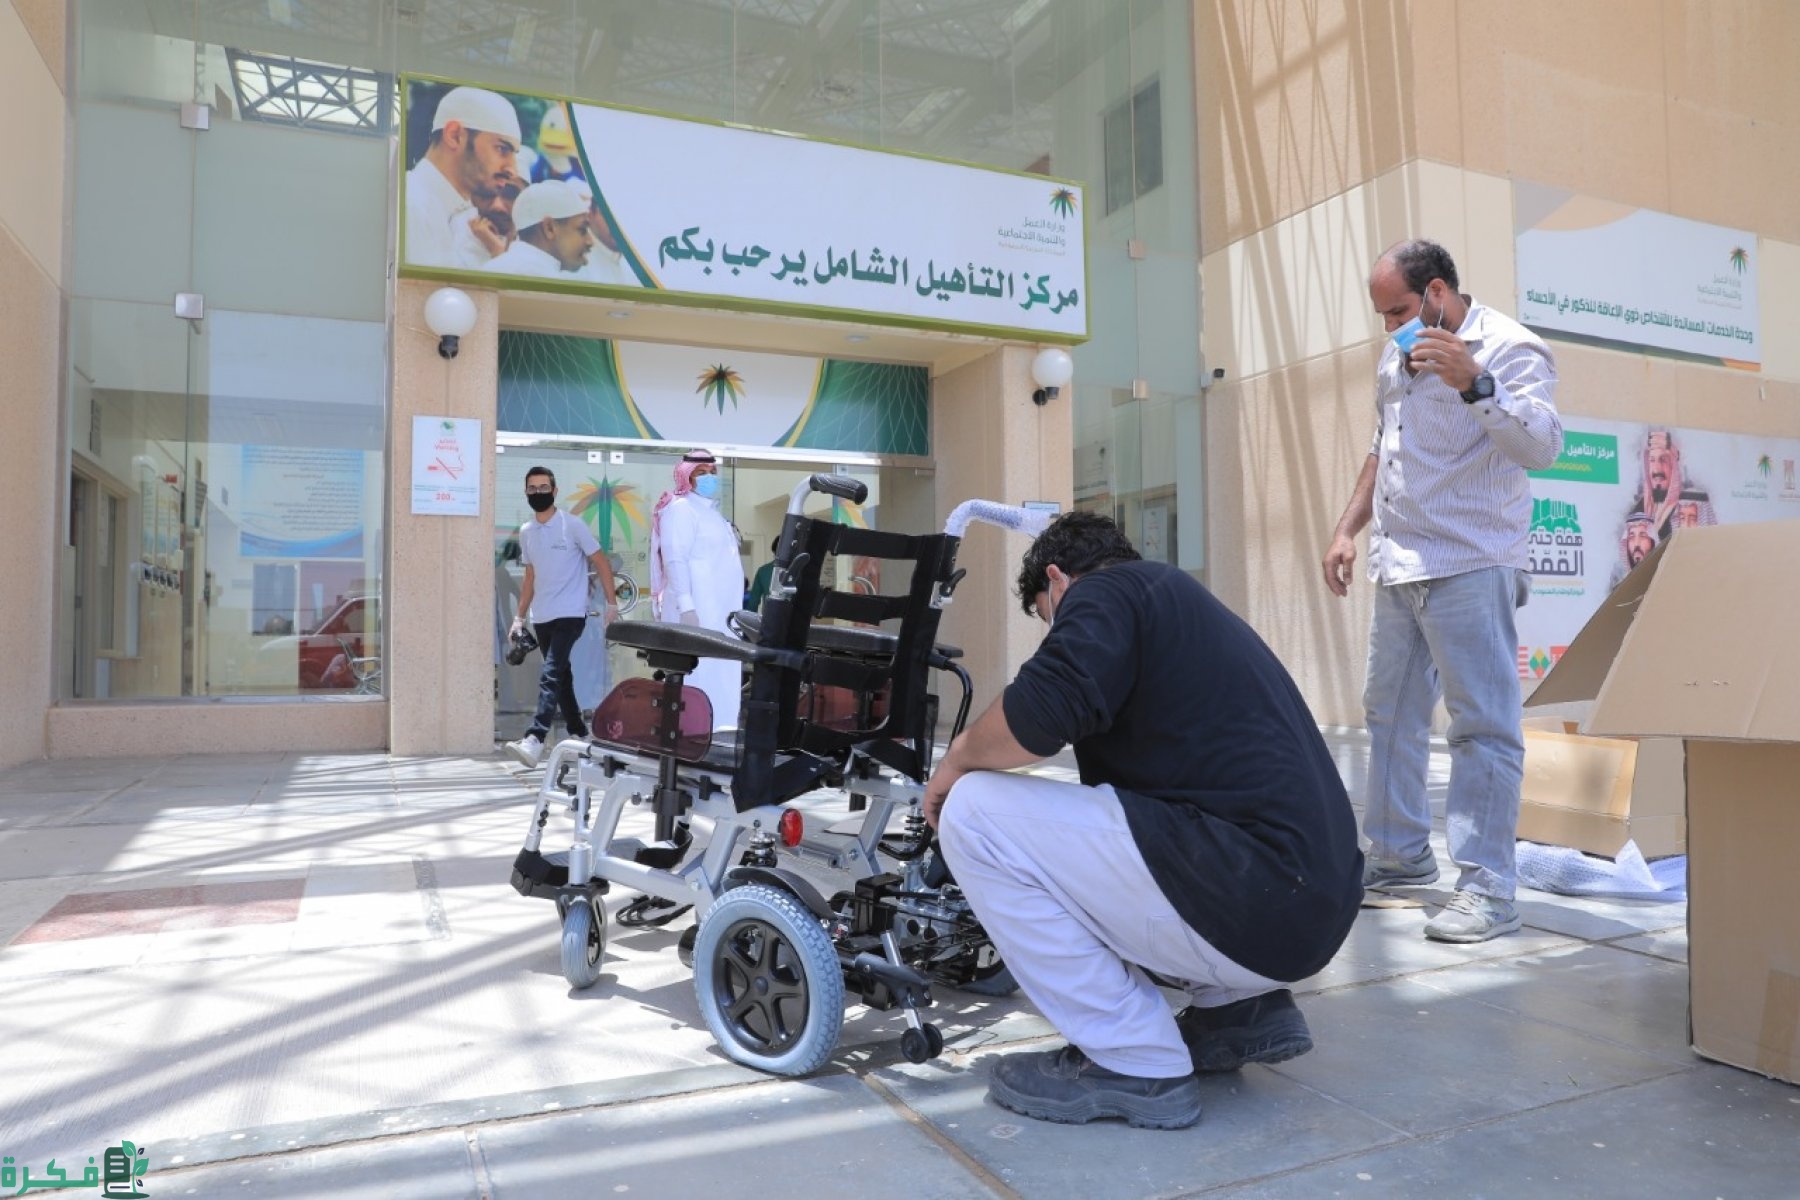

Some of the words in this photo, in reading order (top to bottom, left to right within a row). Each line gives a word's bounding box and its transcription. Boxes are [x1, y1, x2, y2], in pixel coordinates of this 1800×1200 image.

[658, 226, 714, 276] بكم
[722, 242, 808, 286] يرحب
[813, 246, 908, 287] الشامل
[916, 262, 1014, 301] التأهيل
[1019, 271, 1079, 314] مركز
[1526, 286, 1556, 305] الأحساء
[1558, 294, 1569, 315] في
[1567, 443, 1596, 458] التأهيل
[1597, 446, 1615, 460] مركز
